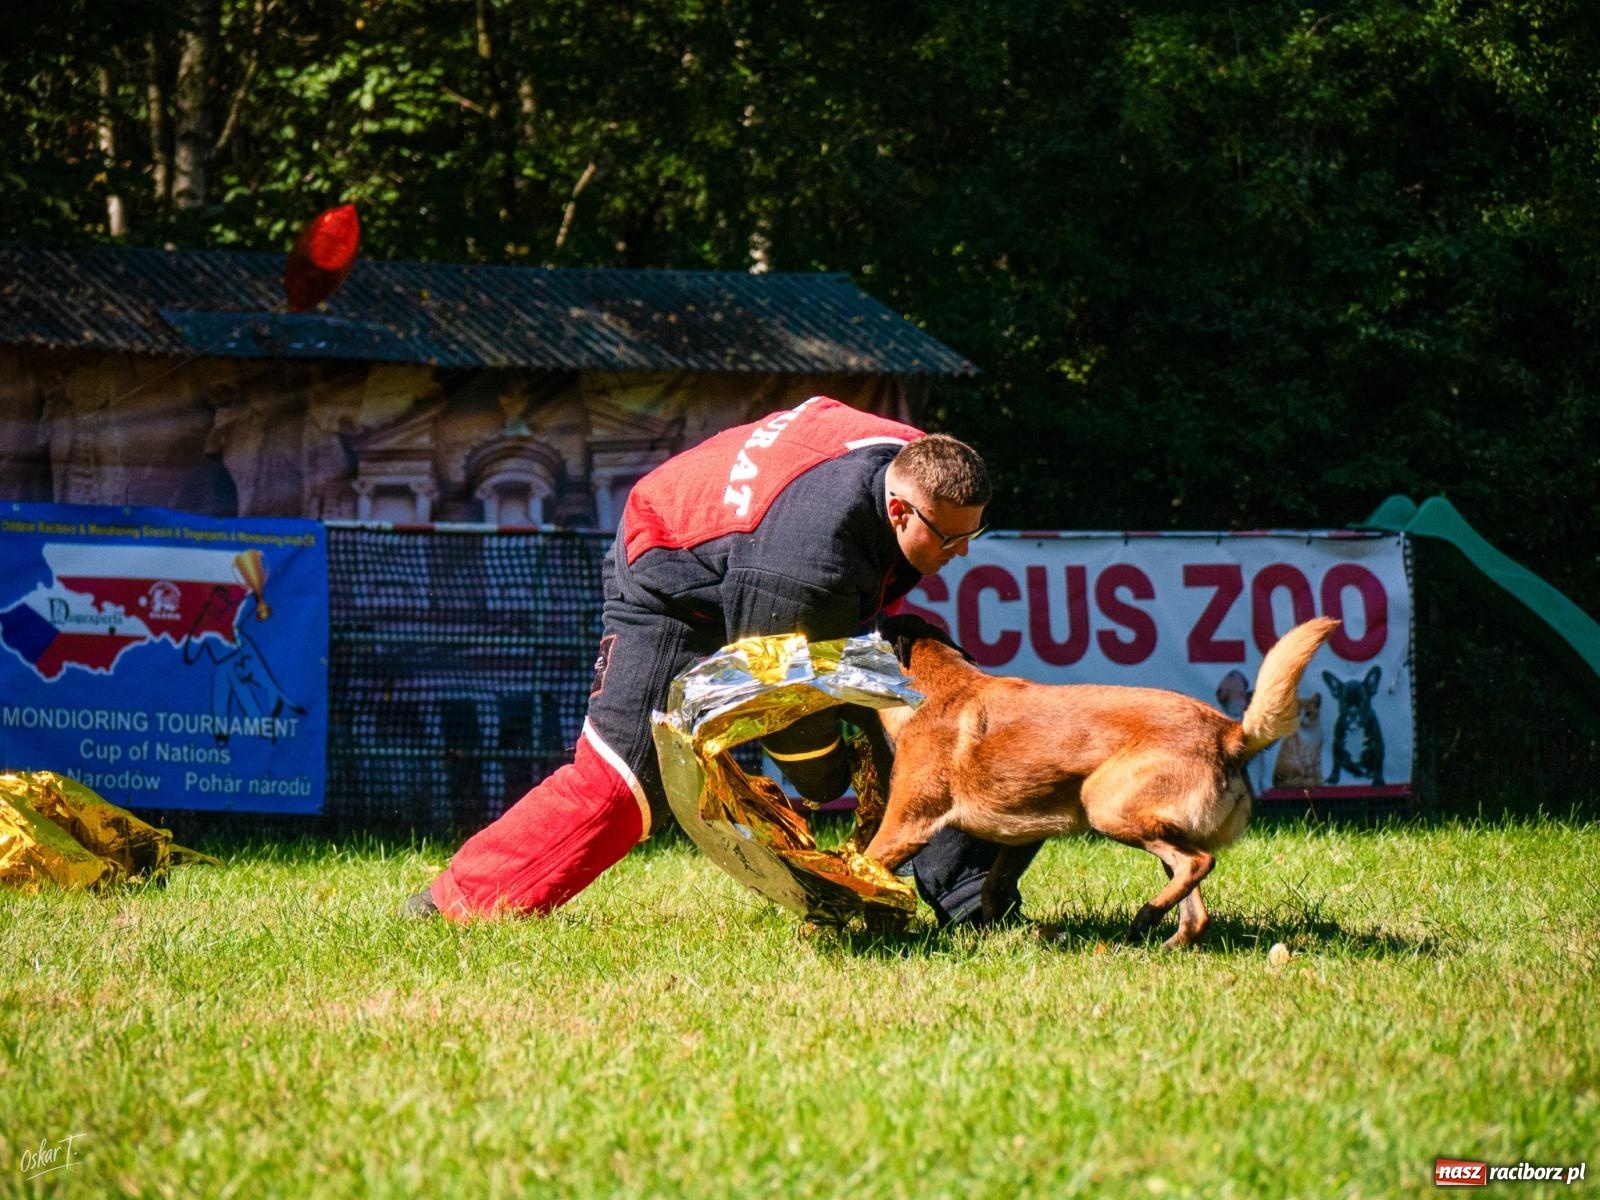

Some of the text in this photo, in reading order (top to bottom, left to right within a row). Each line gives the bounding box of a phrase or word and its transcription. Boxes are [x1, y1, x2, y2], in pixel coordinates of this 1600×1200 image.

[1182, 562, 1389, 664] ZOO
[2, 705, 300, 738] MONDIORING TOURNAMENT
[79, 738, 232, 765] Cup of Nations
[67, 767, 162, 790] Narodów
